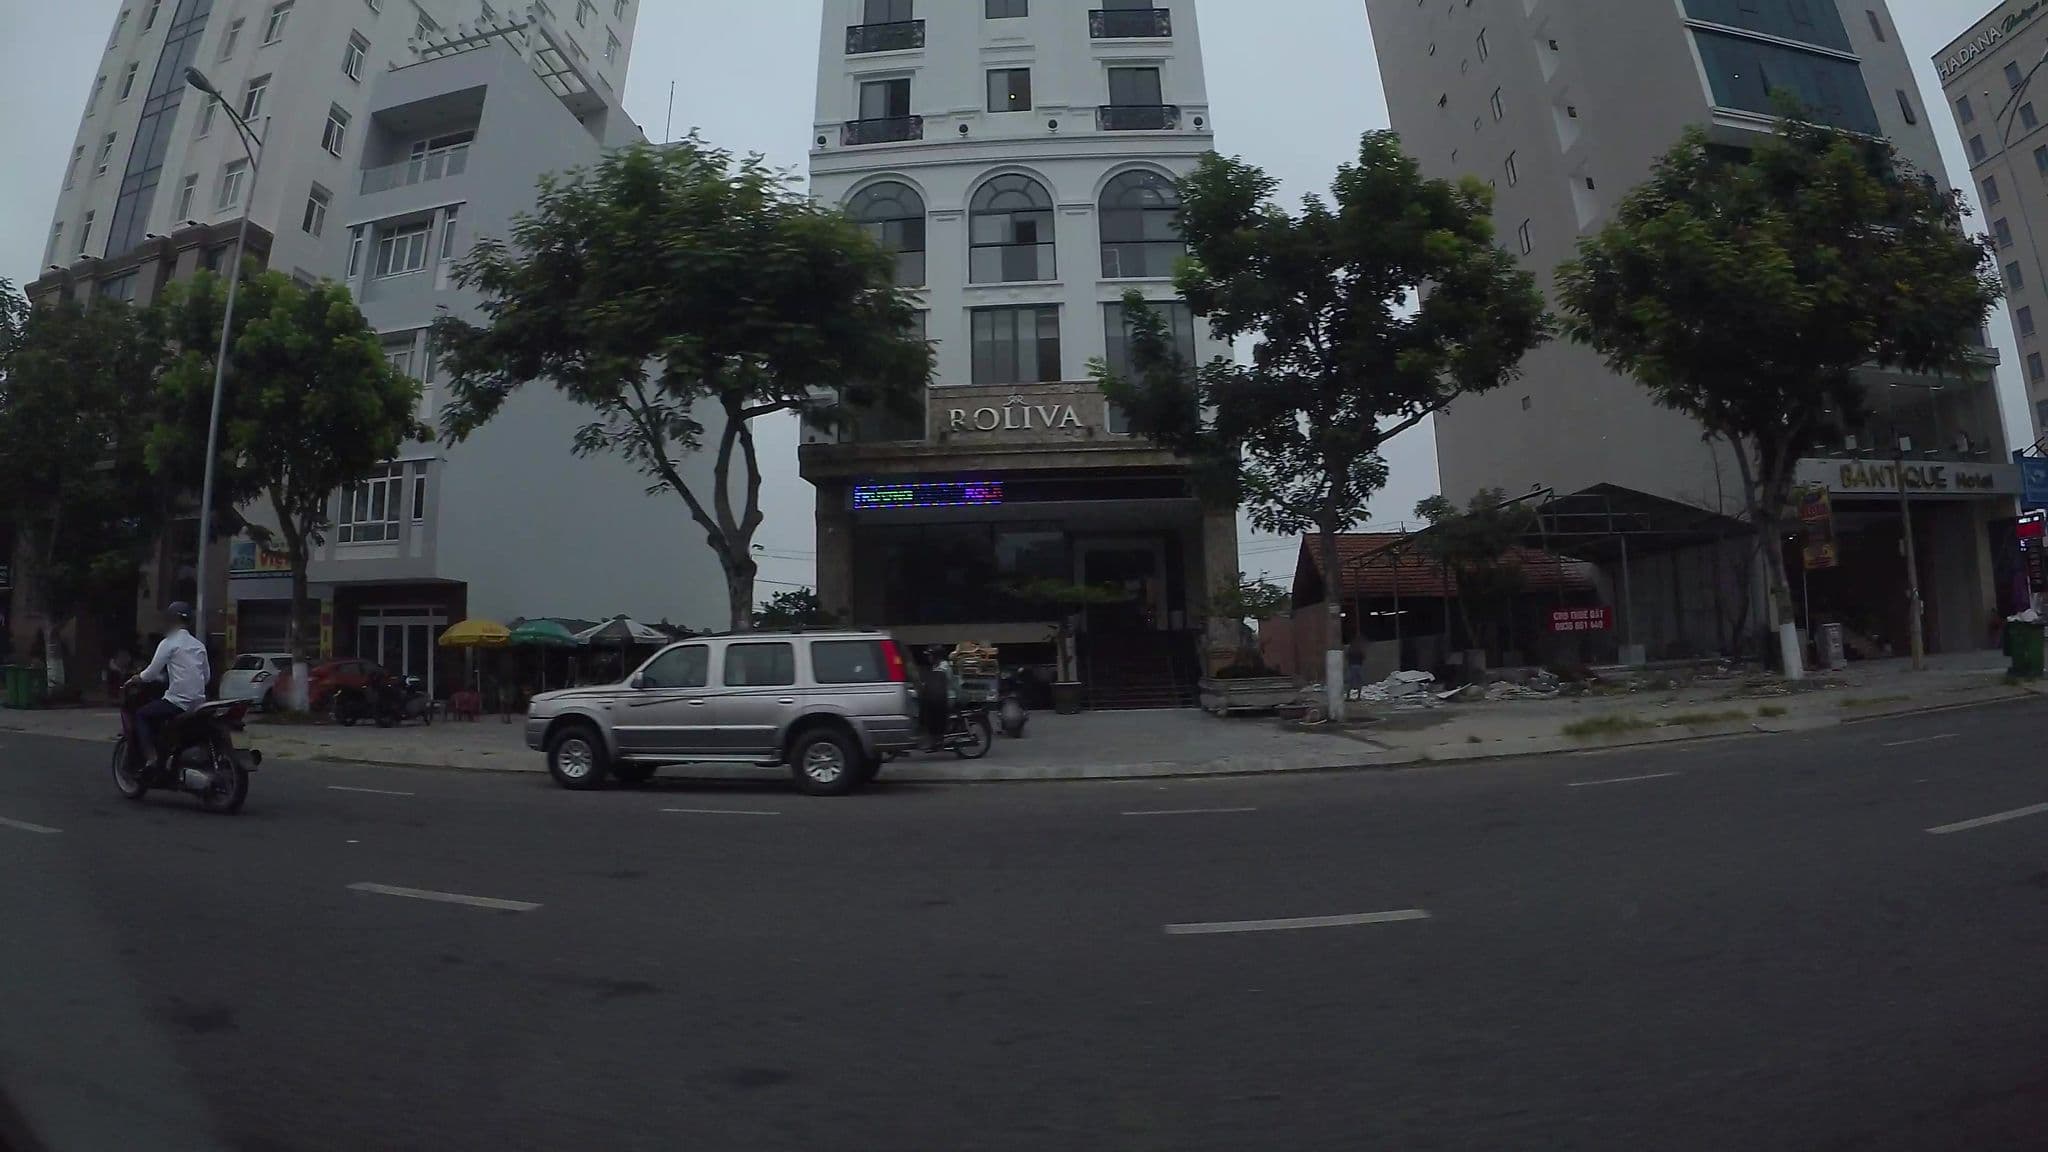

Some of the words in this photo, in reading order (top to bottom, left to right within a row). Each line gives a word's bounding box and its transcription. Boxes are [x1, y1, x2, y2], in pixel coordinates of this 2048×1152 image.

[1938, 27, 2003, 80] HADANA
[949, 404, 1083, 431] ROLIVA
[1840, 465, 1947, 489] BANTQUE
